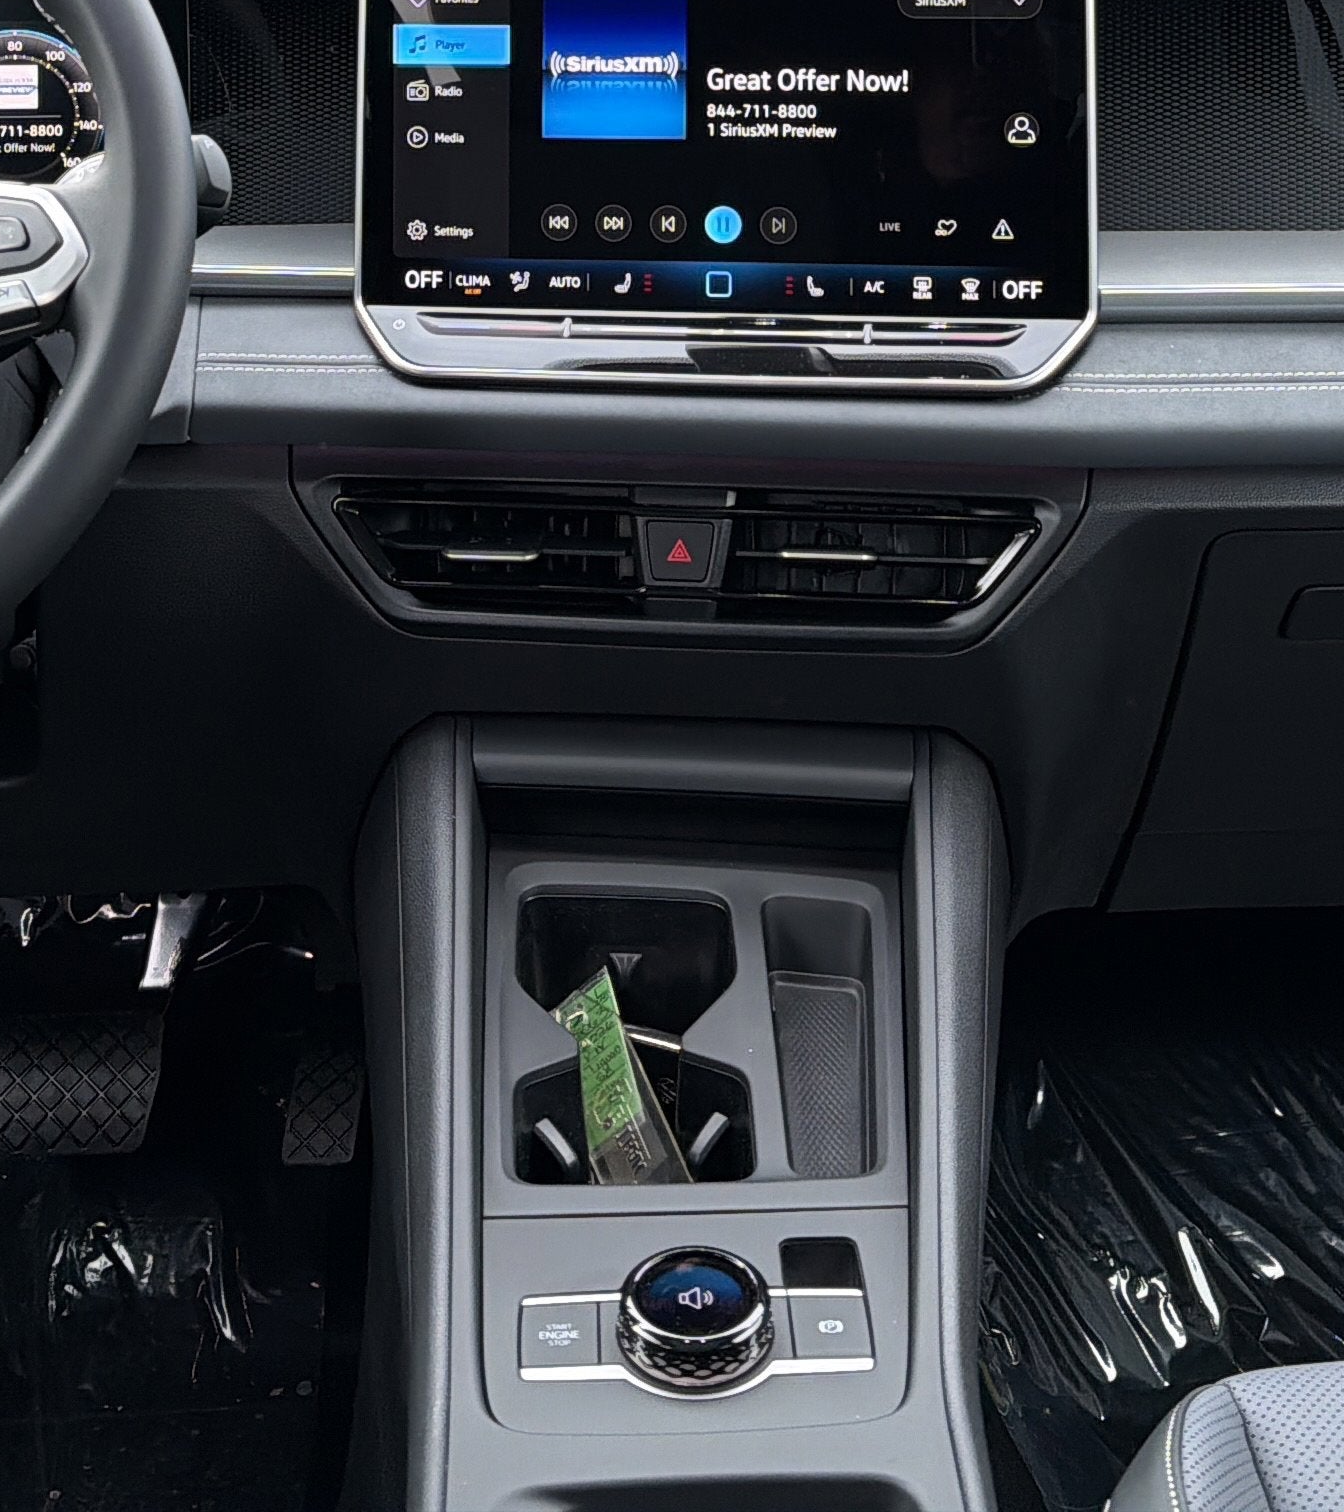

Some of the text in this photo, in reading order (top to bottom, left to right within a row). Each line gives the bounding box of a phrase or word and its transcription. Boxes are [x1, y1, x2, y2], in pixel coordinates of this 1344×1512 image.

[7, 42, 23, 51] 80
[435, 40, 466, 52] Player
[45, 51, 65, 61] 100
[707, 68, 909, 92] Great Offer Now!
[73, 82, 91, 92] 120
[434, 86, 463, 97] Radio
[707, 105, 817, 119] 844-711-8800
[79, 120, 97, 130] 140
[709, 123, 837, 139] 1 SiriusXM Preview
[434, 133, 464, 144] Media
[4, 143, 27, 153] Offer
[30, 143, 55, 152] Now!
[434, 224, 474, 240] Settings
[880, 221, 901, 233] LIVE
[405, 270, 581, 289] OFF CLIMA AUTO
[864, 281, 885, 293] A/C
[1002, 280, 1043, 299] OFF
[538, 1331, 580, 1340] ENGINE
